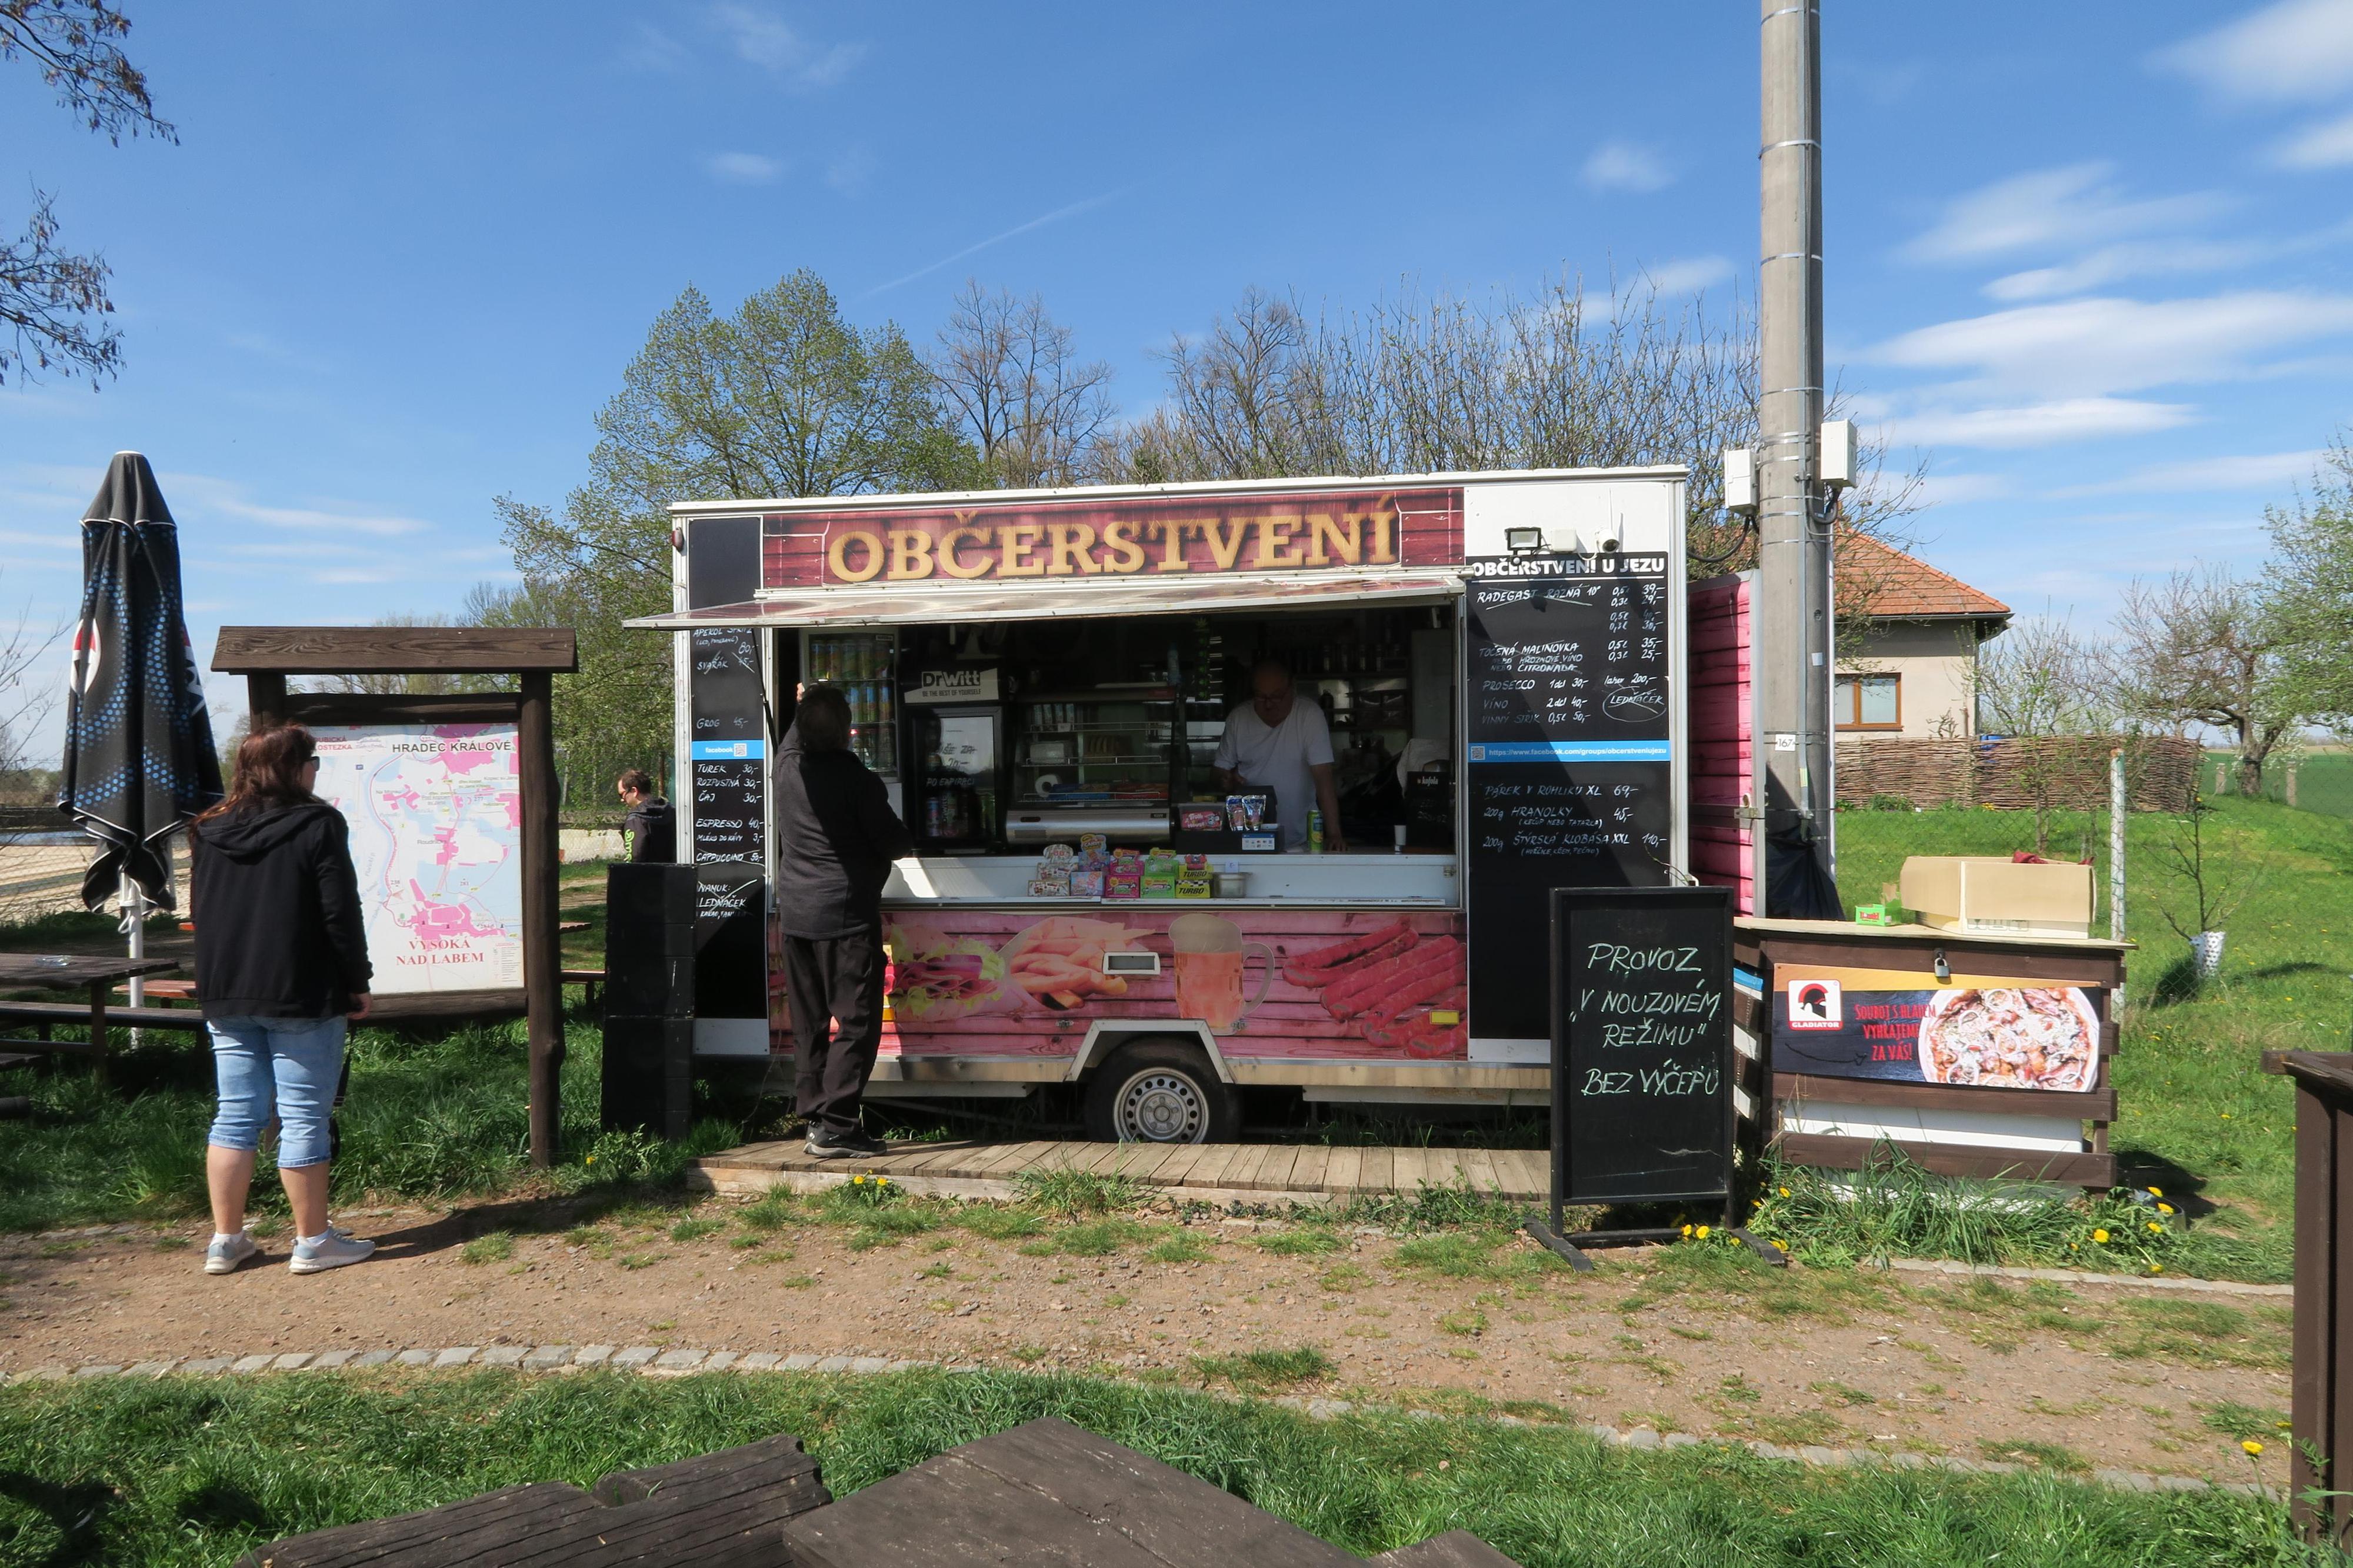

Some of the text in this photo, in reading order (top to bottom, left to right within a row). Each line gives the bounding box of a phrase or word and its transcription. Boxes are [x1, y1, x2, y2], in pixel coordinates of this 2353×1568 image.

[828, 493, 1399, 582] OBČERSTVENÍ
[1602, 559, 1615, 573] U
[1620, 558, 1665, 573] JEZU
[1477, 589, 1539, 603] RADEGAST
[1642, 583, 1665, 596] 39,-
[738, 641, 759, 655] 80,-
[1479, 640, 1518, 656] TOČENÁ
[1521, 642, 1579, 656] MALINOVKA
[1641, 638, 1664, 649] 35,-
[697, 655, 728, 670] SVAŘÁK
[1562, 652, 1583, 662] VÍNO
[1641, 650, 1662, 661] 25,-
[1482, 679, 1535, 690] PROSECCO
[1571, 678, 1589, 688] 30,-
[1631, 673, 1657, 685] 200,-
[1483, 699, 1509, 709] VÍNO
[1571, 698, 1588, 708] 40,-
[696, 717, 748, 729] GROG 45,-
[1482, 712, 1511, 725] VINNÝ
[1573, 712, 1591, 724] 50,-
[392, 741, 511, 752] HRADEC KRÁLOVÉ
[1778, 739, 1793, 748] 167
[1489, 748, 1667, 756] https://www.facebook.com/groups/obcerstveniujezu
[697, 763, 759, 775] TUREK 30,-
[696, 774, 761, 789] ROZPUSTNÁ 30,-
[926, 778, 937, 786] PO
[1422, 776, 1438, 786] kofola
[698, 790, 762, 803] ČAJ 30,-
[1485, 783, 1521, 795] PÁREK
[1586, 785, 1602, 795] XL
[1614, 785, 1639, 798] 69,-
[1484, 806, 1634, 823] 200g HRANOLKY 45,-
[695, 818, 764, 829] ESPRESSO 40,-
[696, 832, 717, 841] MLÉKO
[728, 832, 743, 842] KÁVY
[752, 833, 764, 844] 3,-
[1482, 830, 1667, 852] 200g ŠTÝRSKÁ KLOBÁSA XXL 110,-
[696, 852, 744, 862] CAPPUCCINO
[409, 939, 471, 950] VYSOKÁ
[396, 953, 484, 966] NAD LABEM
[1588, 943, 1701, 972] PROVOZ
[1601, 979, 1722, 1021] NOUZOVÉM
[1854, 1004, 1936, 1020] SOUBOJ S HLADEM
[1871, 1041, 1912, 1061] ZA VÁS!
[1581, 1059, 1719, 1096] BEZ VÝČEPU
